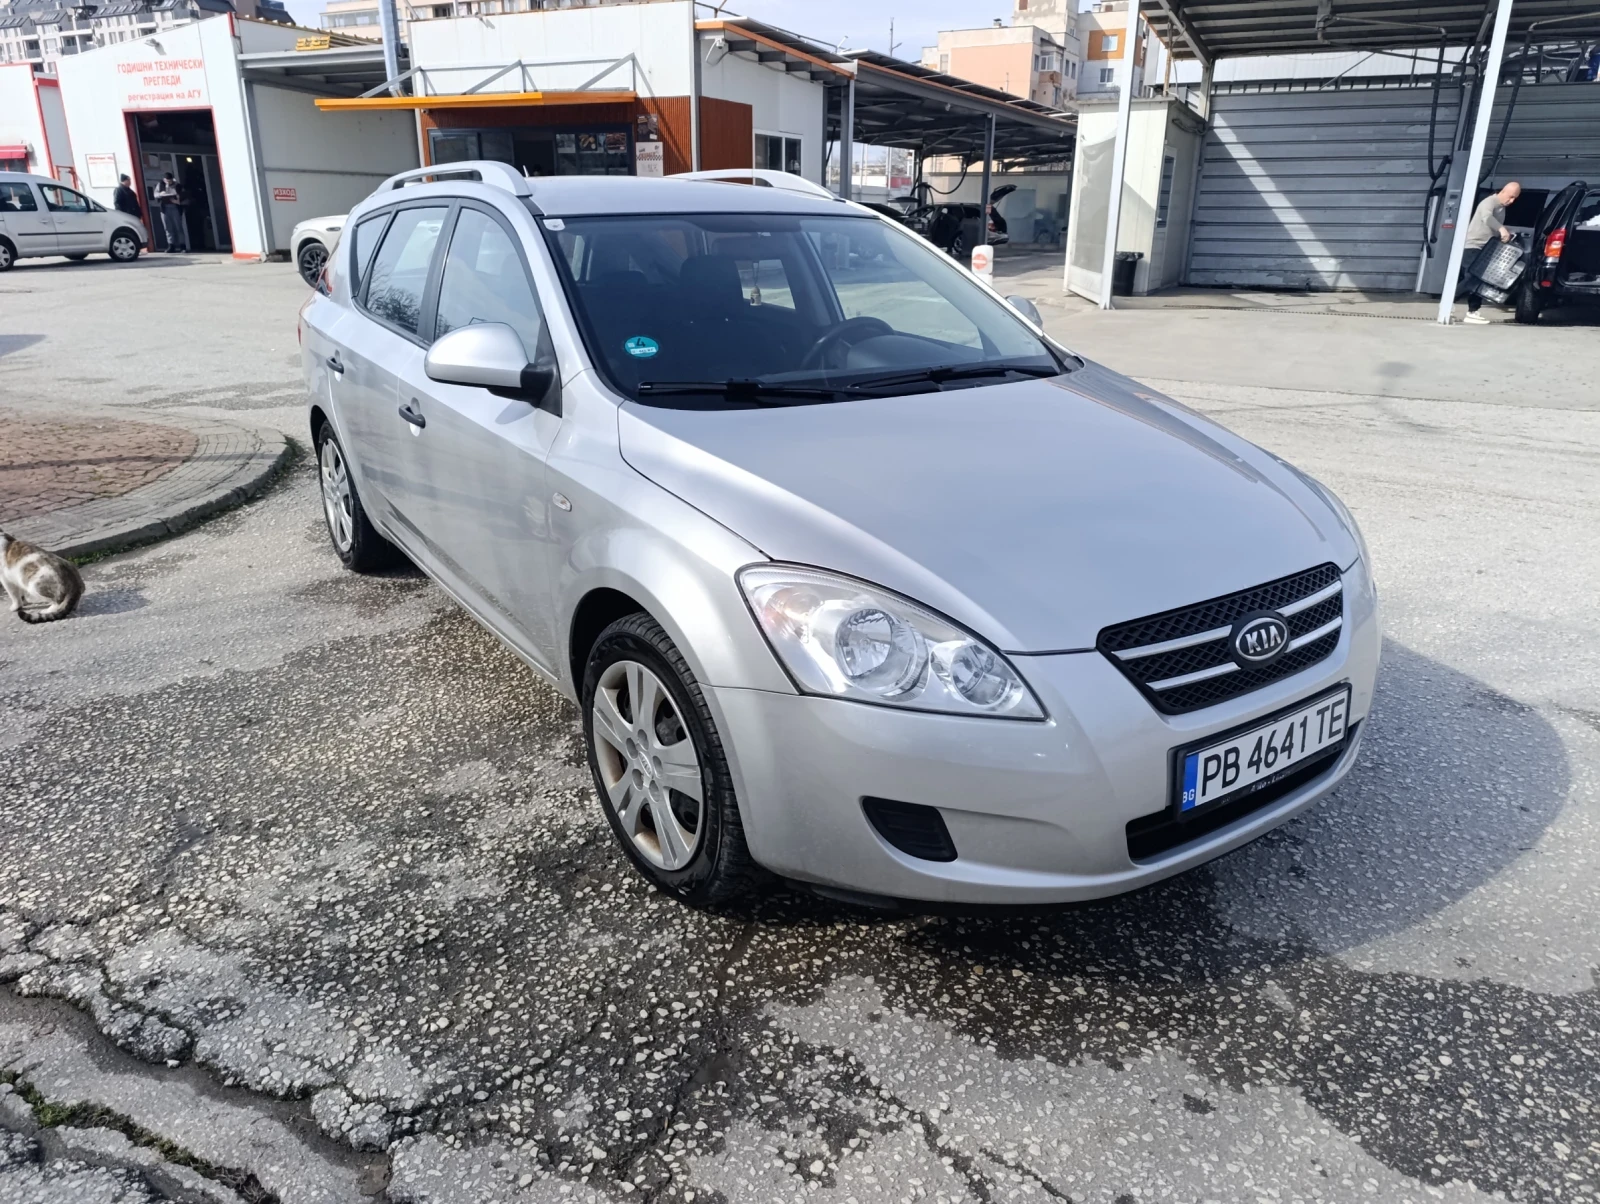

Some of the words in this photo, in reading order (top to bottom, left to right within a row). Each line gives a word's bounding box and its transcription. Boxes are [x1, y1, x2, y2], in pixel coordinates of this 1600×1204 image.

[117, 61, 153, 74] ГОДИШНИ
[154, 59, 204, 71] ТЕХНИЧЕСКИ
[143, 75, 181, 87] ПРЕГЛЕДИ
[128, 92, 174, 102] регистрация
[176, 91, 185, 99] на
[187, 89, 201, 99] АГУ
[1245, 625, 1282, 654] KIA
[1201, 746, 1240, 797] PB
[1247, 715, 1308, 775] 4641
[1316, 698, 1345, 744] TE
[1182, 788, 1195, 804] BG
